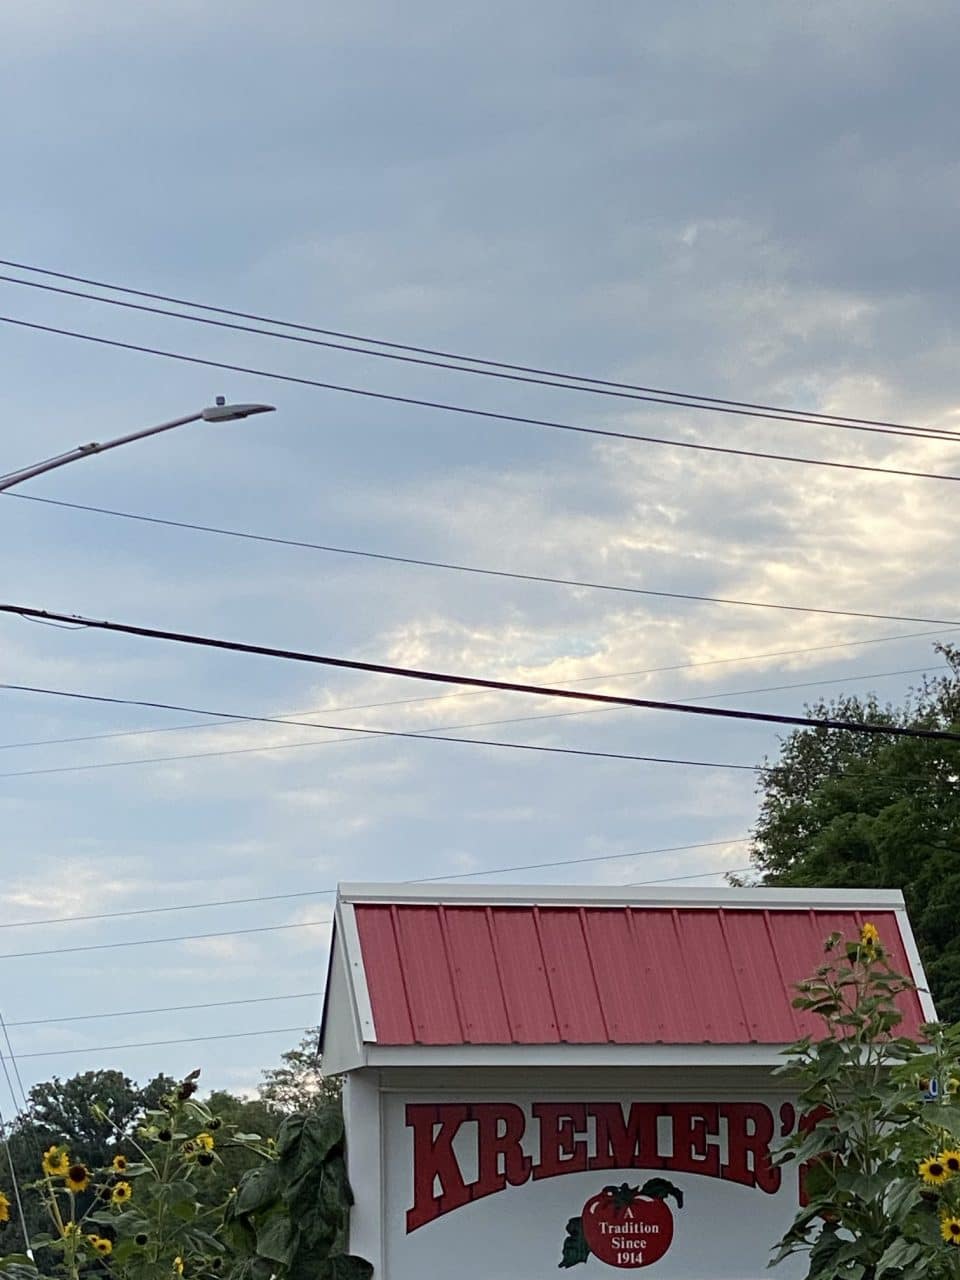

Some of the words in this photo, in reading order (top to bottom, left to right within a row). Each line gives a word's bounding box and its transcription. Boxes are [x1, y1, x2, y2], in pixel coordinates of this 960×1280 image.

[624, 1207, 634, 1219] A
[599, 1221, 660, 1234] Tradition
[611, 1236, 647, 1249] Since
[617, 1251, 643, 1264] 1914
